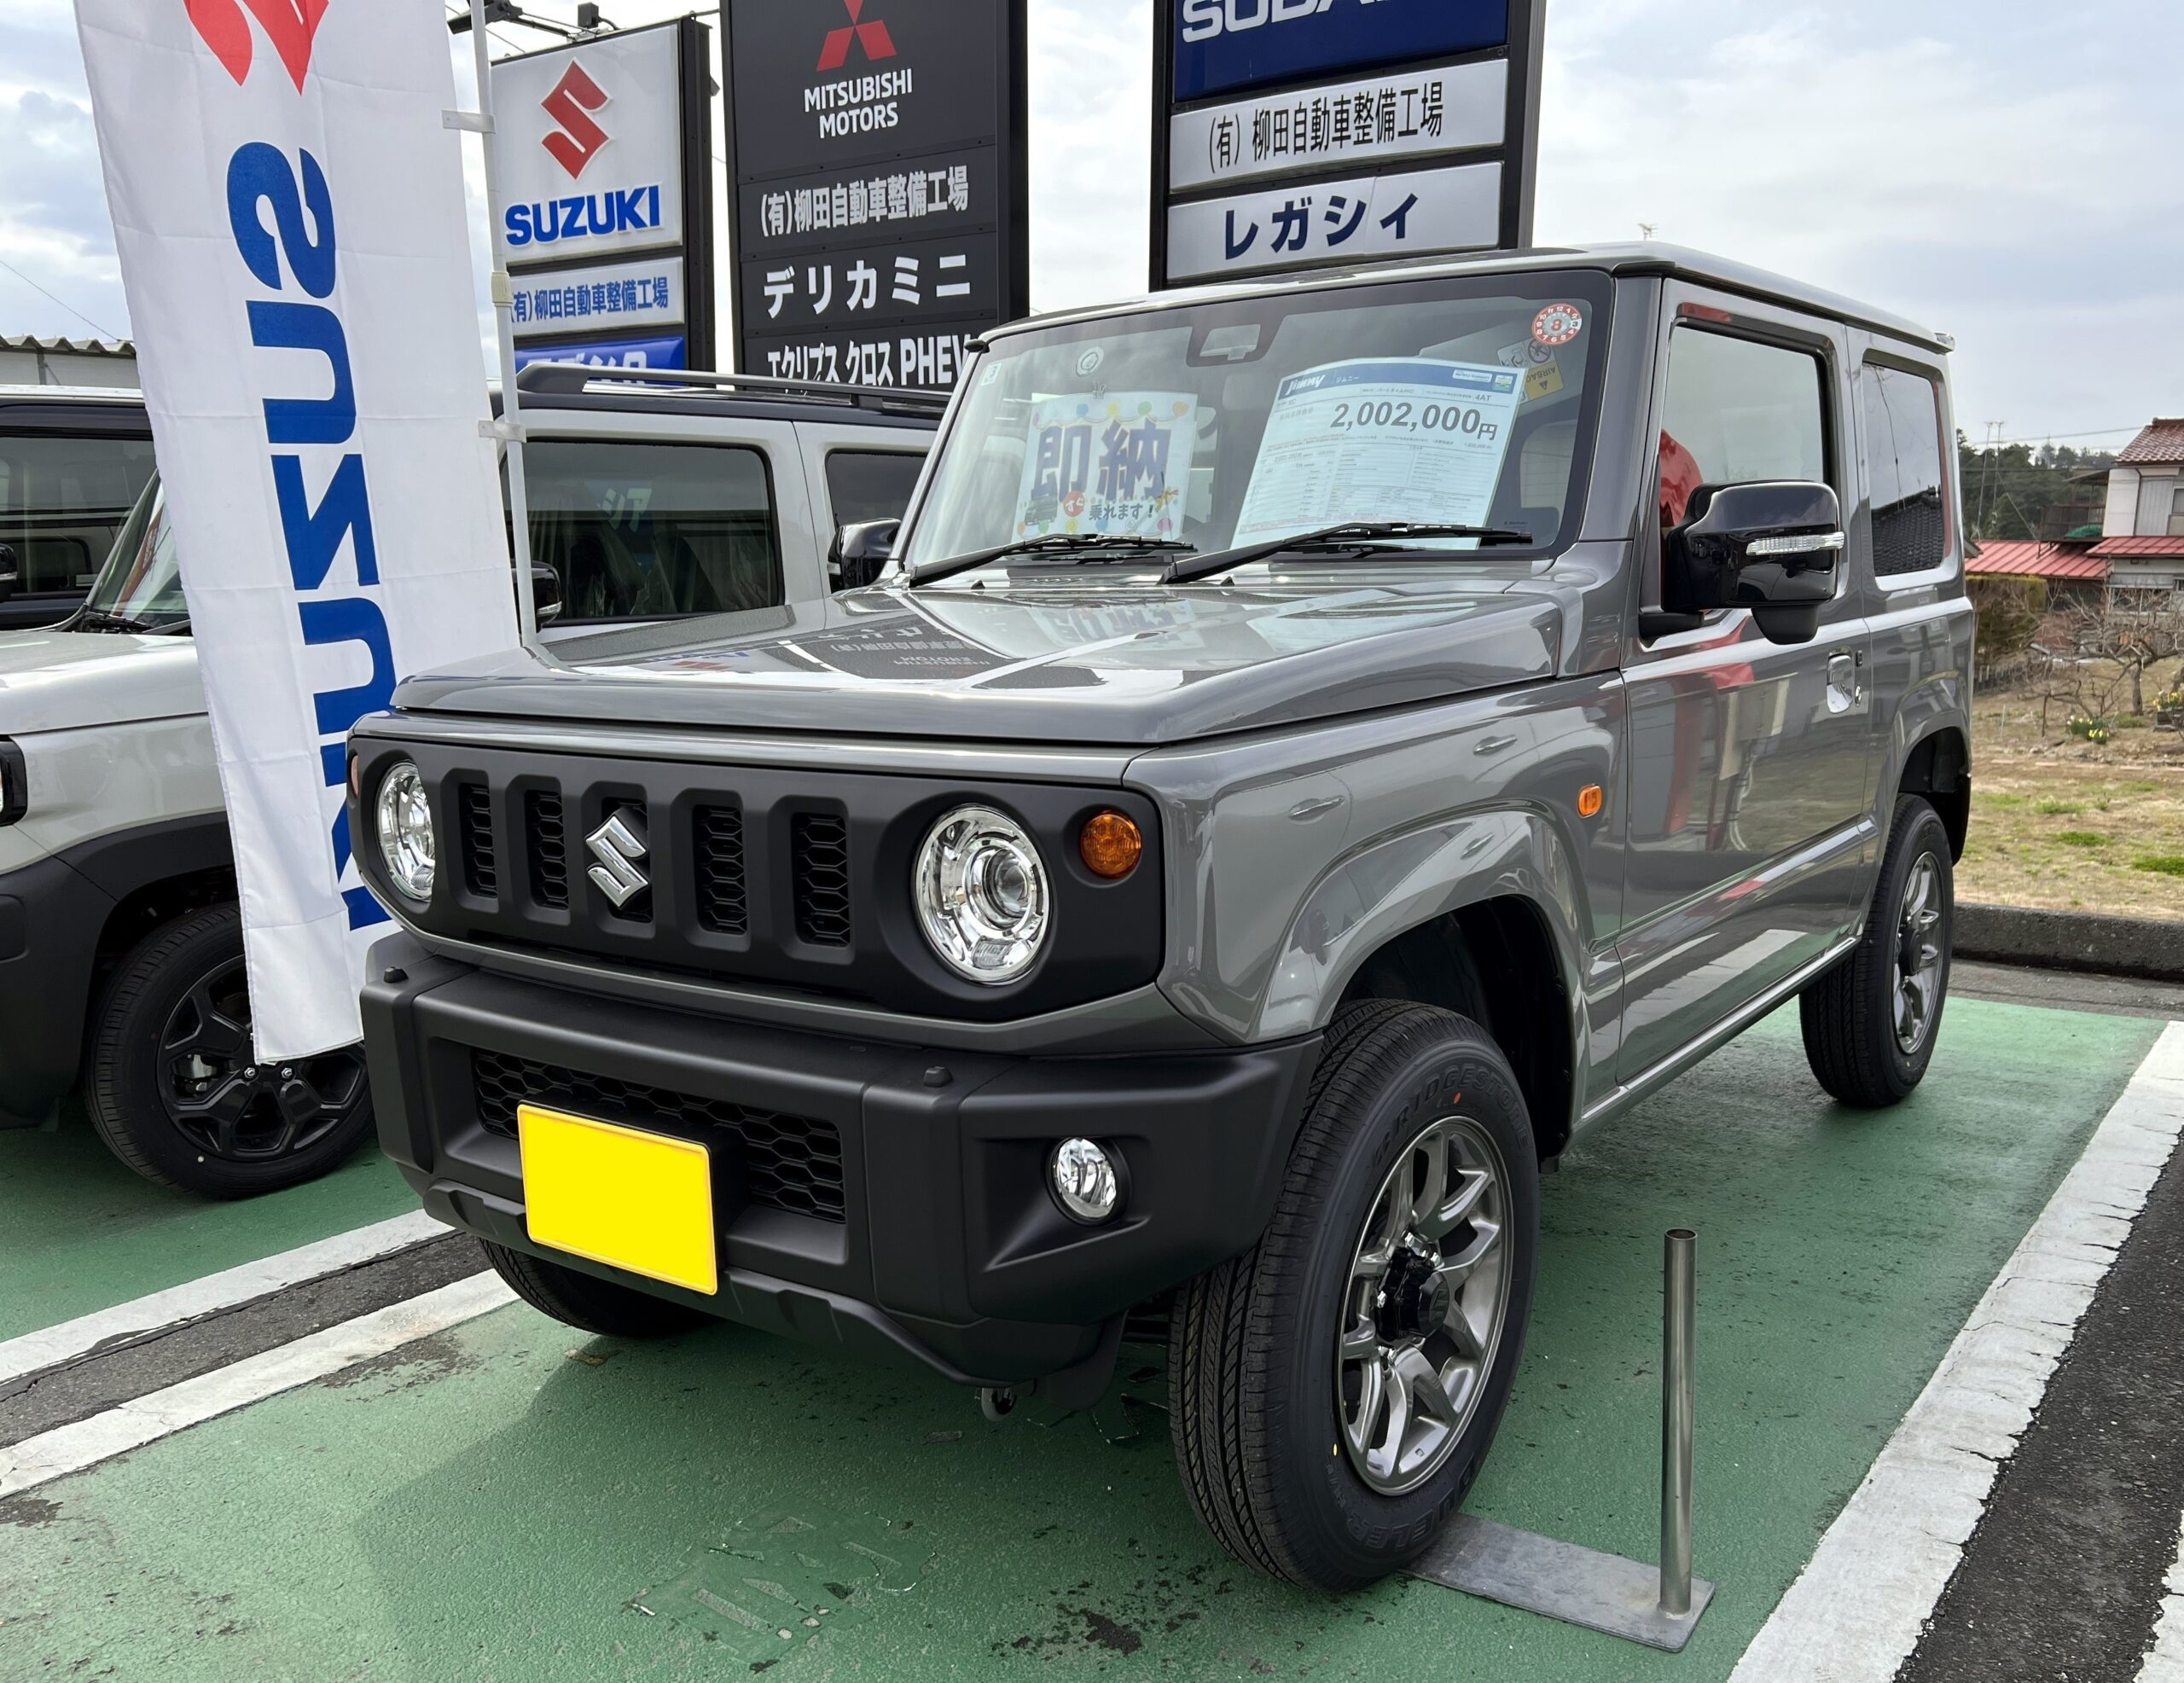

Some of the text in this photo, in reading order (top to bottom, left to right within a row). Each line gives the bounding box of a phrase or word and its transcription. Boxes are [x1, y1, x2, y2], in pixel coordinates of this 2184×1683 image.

[804, 68, 913, 113] MITSUBISHI
[819, 102, 899, 139] MOTORS
[1210, 81, 1443, 173] (有)柳田自動車整備工場
[505, 184, 661, 247] SUZUKI
[760, 165, 969, 237] (有)柳田自動車整備工場
[764, 253, 971, 319] デリカミニ
[1551, 318, 1562, 331] 8
[845, 340, 894, 386] クロス
[1285, 374, 1327, 396] Jimny
[1335, 375, 1361, 384] ジムニー
[1330, 401, 1497, 441] 2,002,000円
[1474, 394, 1492, 403] 4AT
[1031, 417, 1172, 502] 即納
